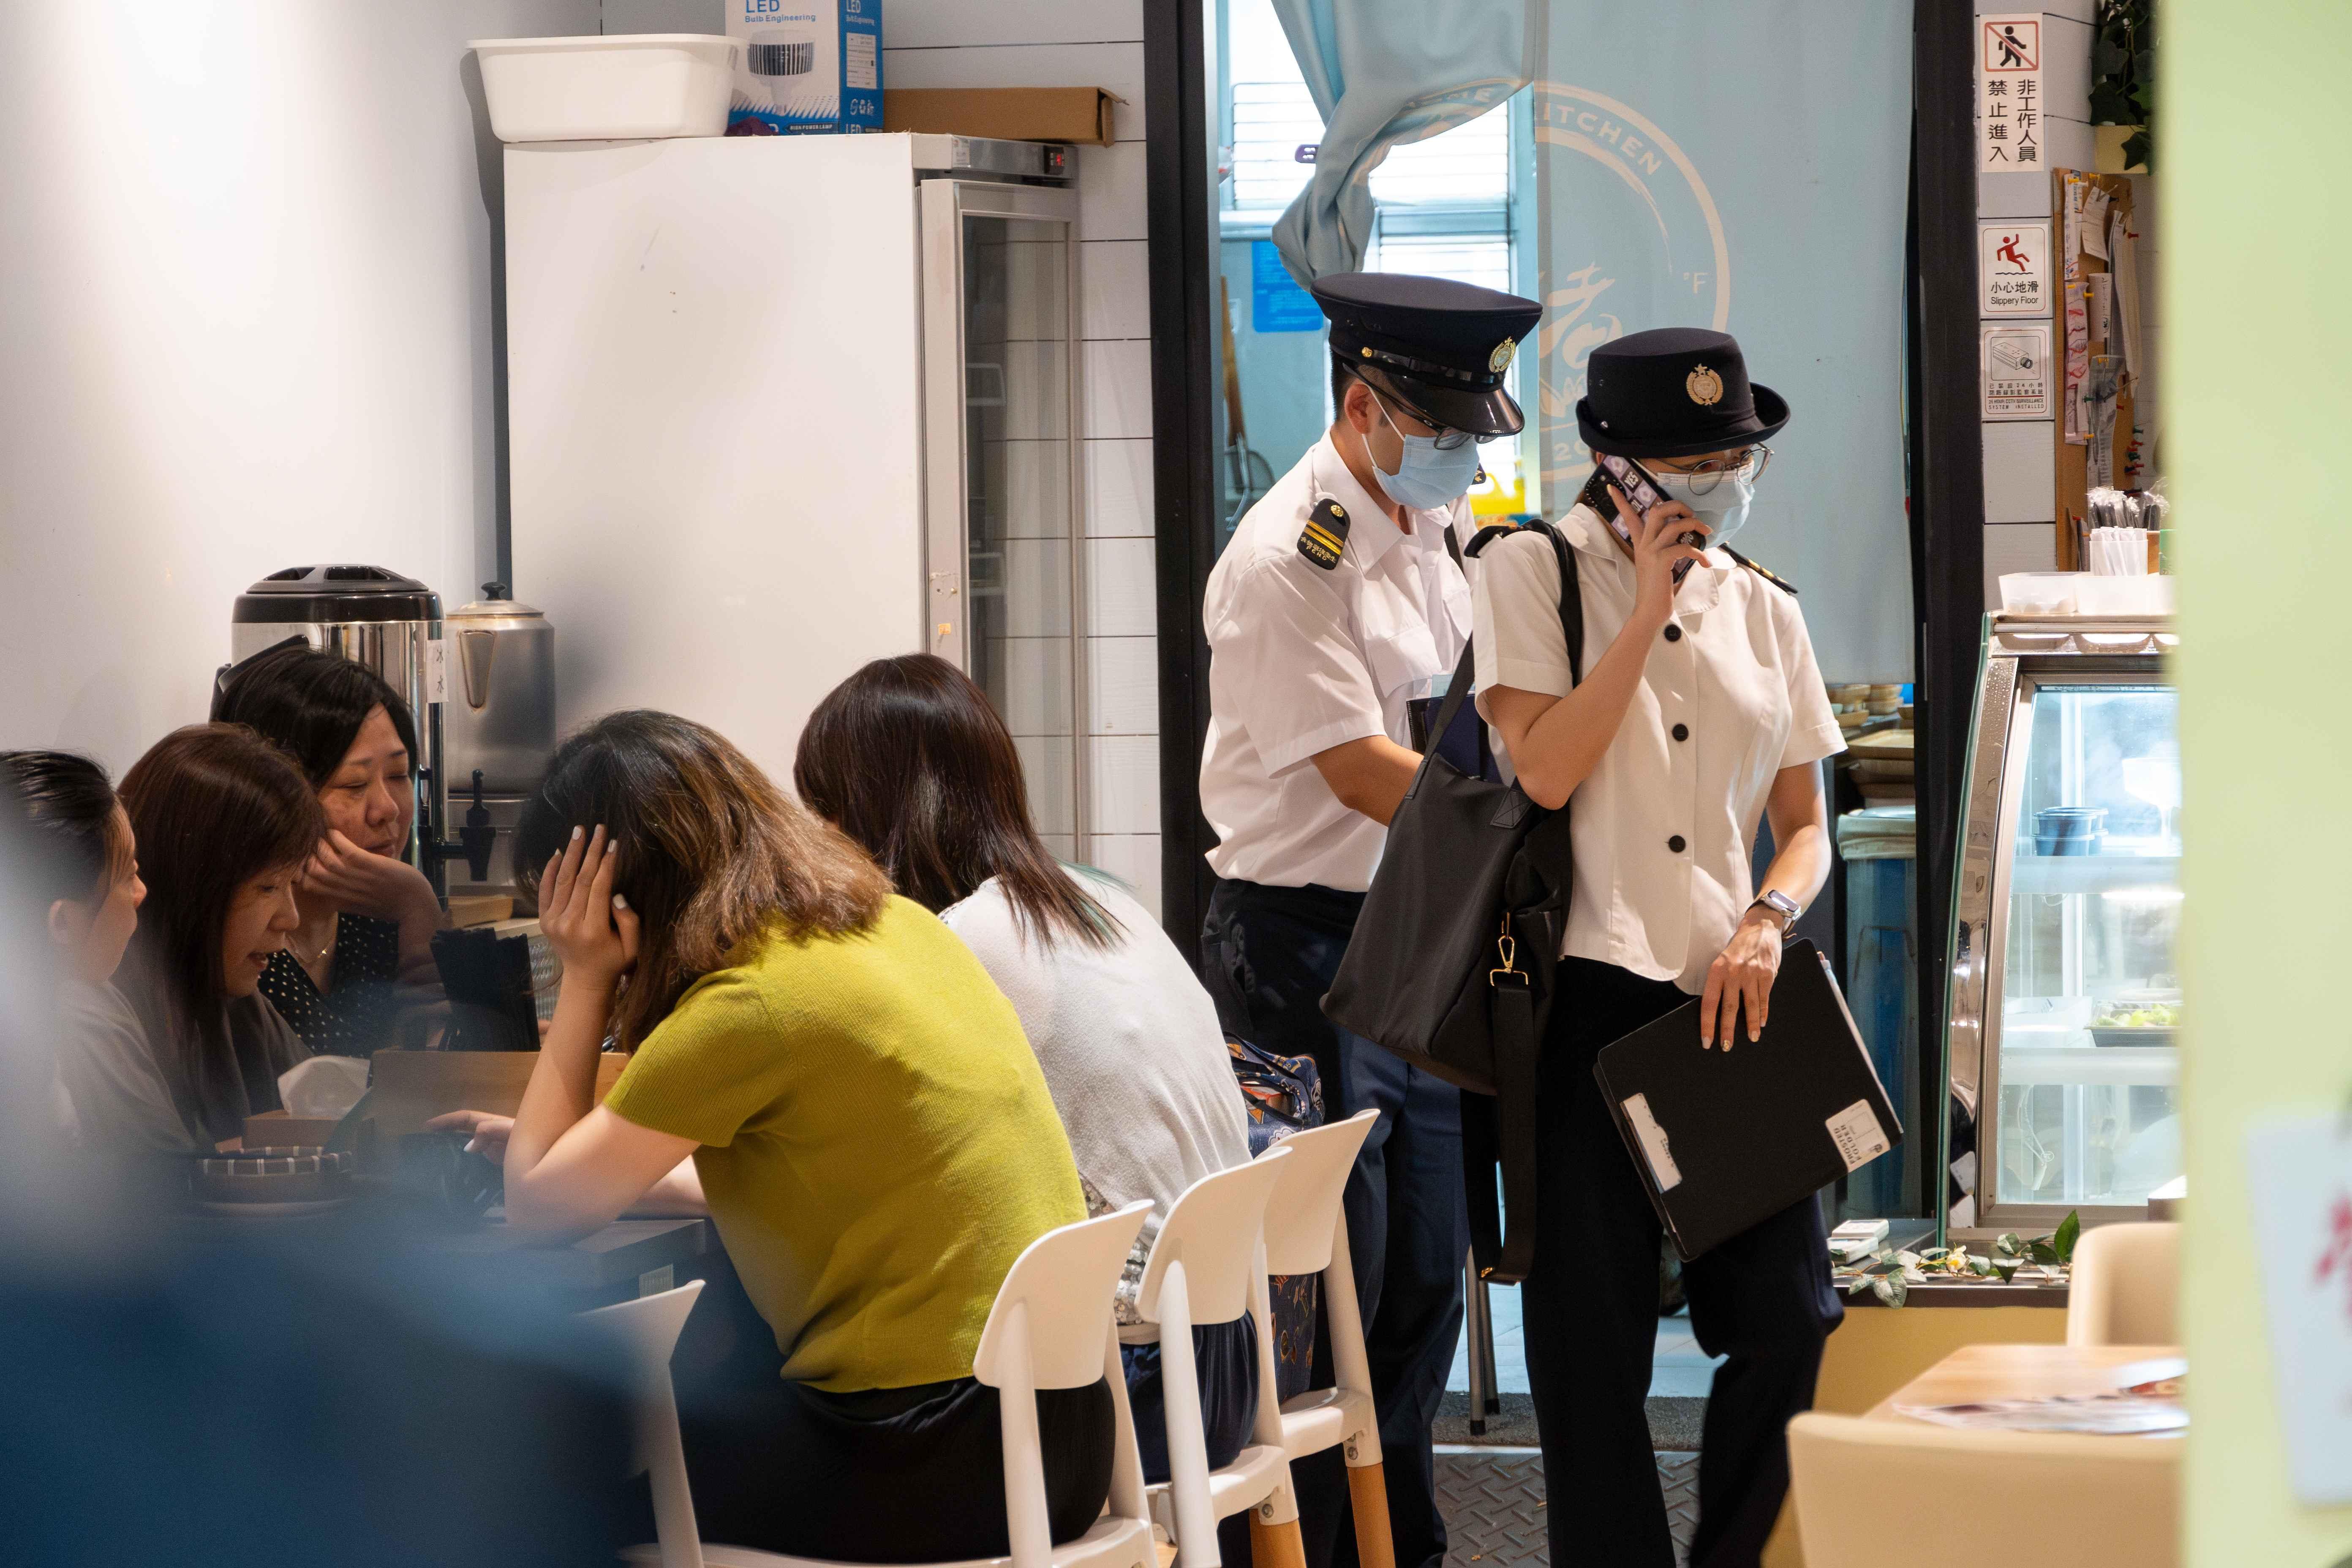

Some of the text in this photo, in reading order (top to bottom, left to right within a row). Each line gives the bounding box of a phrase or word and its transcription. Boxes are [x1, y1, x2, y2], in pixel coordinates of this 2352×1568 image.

[746, 0, 780, 13] LED
[765, 14, 816, 23] Engineering
[1988, 79, 2009, 162] 禁止進入
[2017, 79, 2037, 162] 非工作人員
[1990, 281, 2039, 294] 小心地滑
[1991, 296, 2039, 306] Slippery Floor
[1834, 1128, 1856, 1165] FROSTED
[1840, 1124, 1862, 1161] FOLDER
